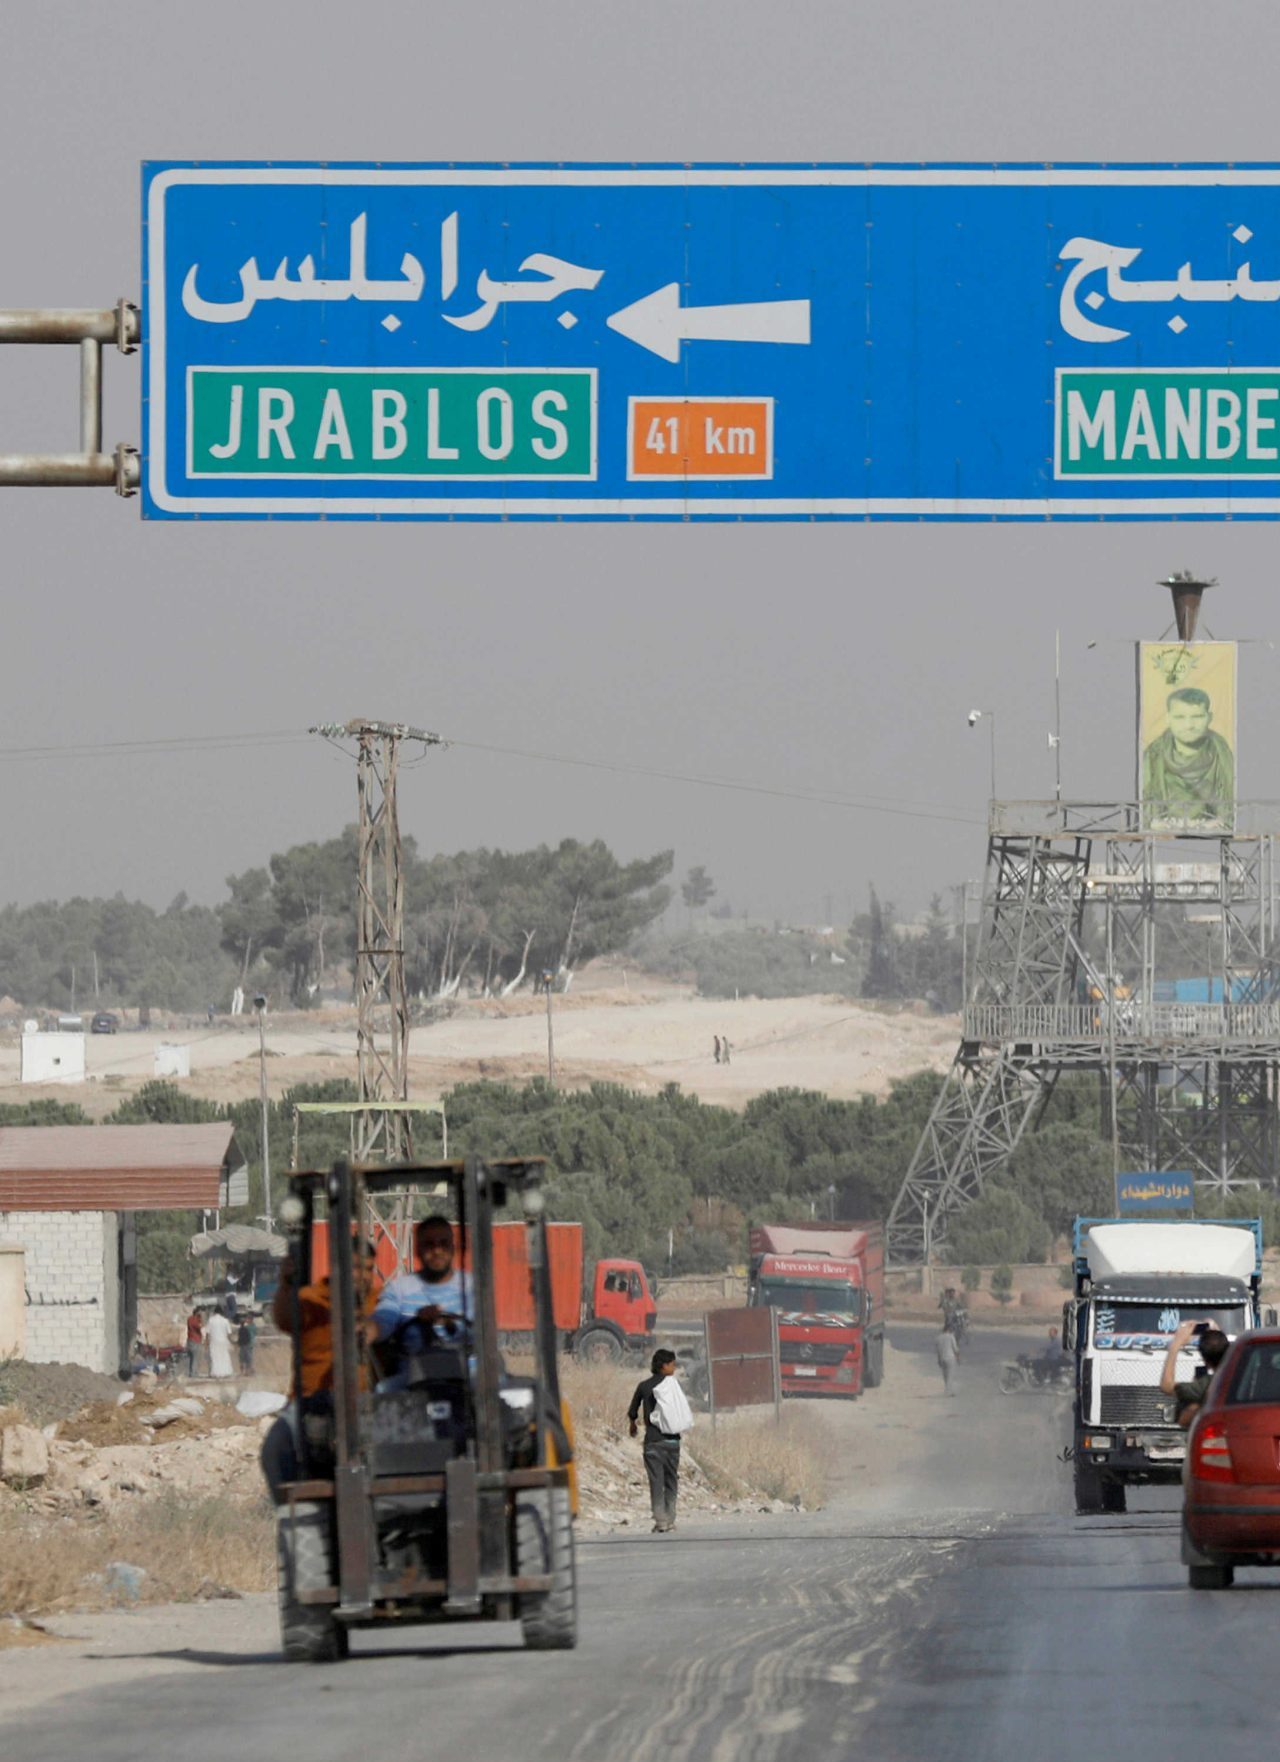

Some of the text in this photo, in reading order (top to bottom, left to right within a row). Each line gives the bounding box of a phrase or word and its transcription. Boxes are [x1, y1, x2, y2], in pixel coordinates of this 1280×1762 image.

[182, 211, 605, 332] جرابلس
[209, 384, 570, 461] JRABLOS
[646, 417, 756, 455] 41 km
